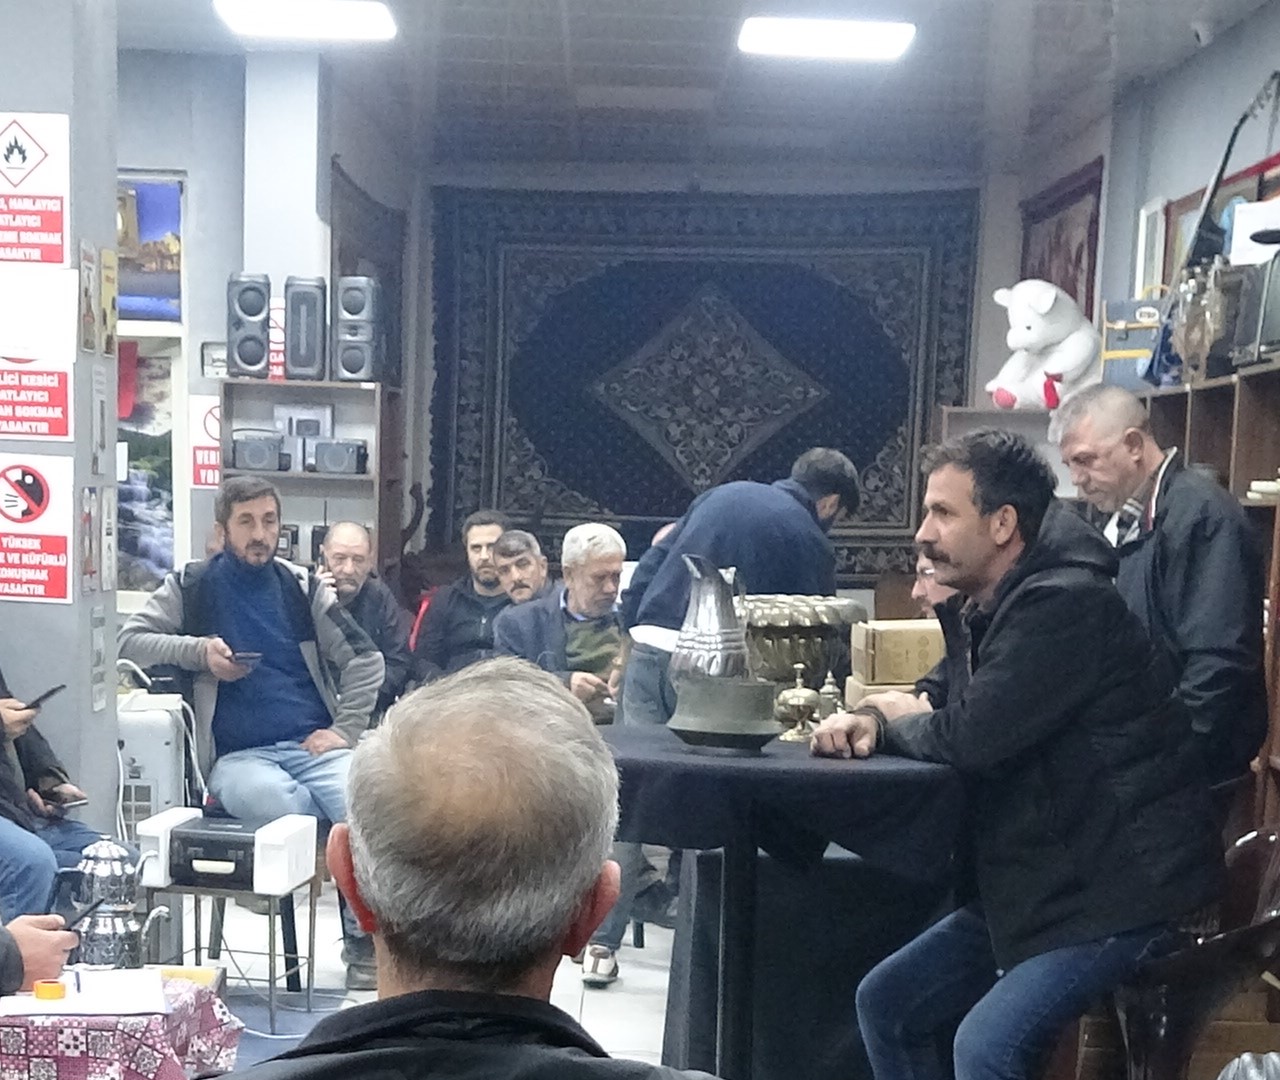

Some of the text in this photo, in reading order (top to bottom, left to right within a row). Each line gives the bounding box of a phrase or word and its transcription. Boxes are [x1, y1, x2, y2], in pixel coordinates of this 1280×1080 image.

[22, 374, 58, 386] KESİCİ
[16, 406, 63, 418] SOKMAK
[2, 536, 40, 549] YÜKSEK
[7, 553, 20, 564] VE
[22, 552, 66, 566] KÜFÜRLÜ
